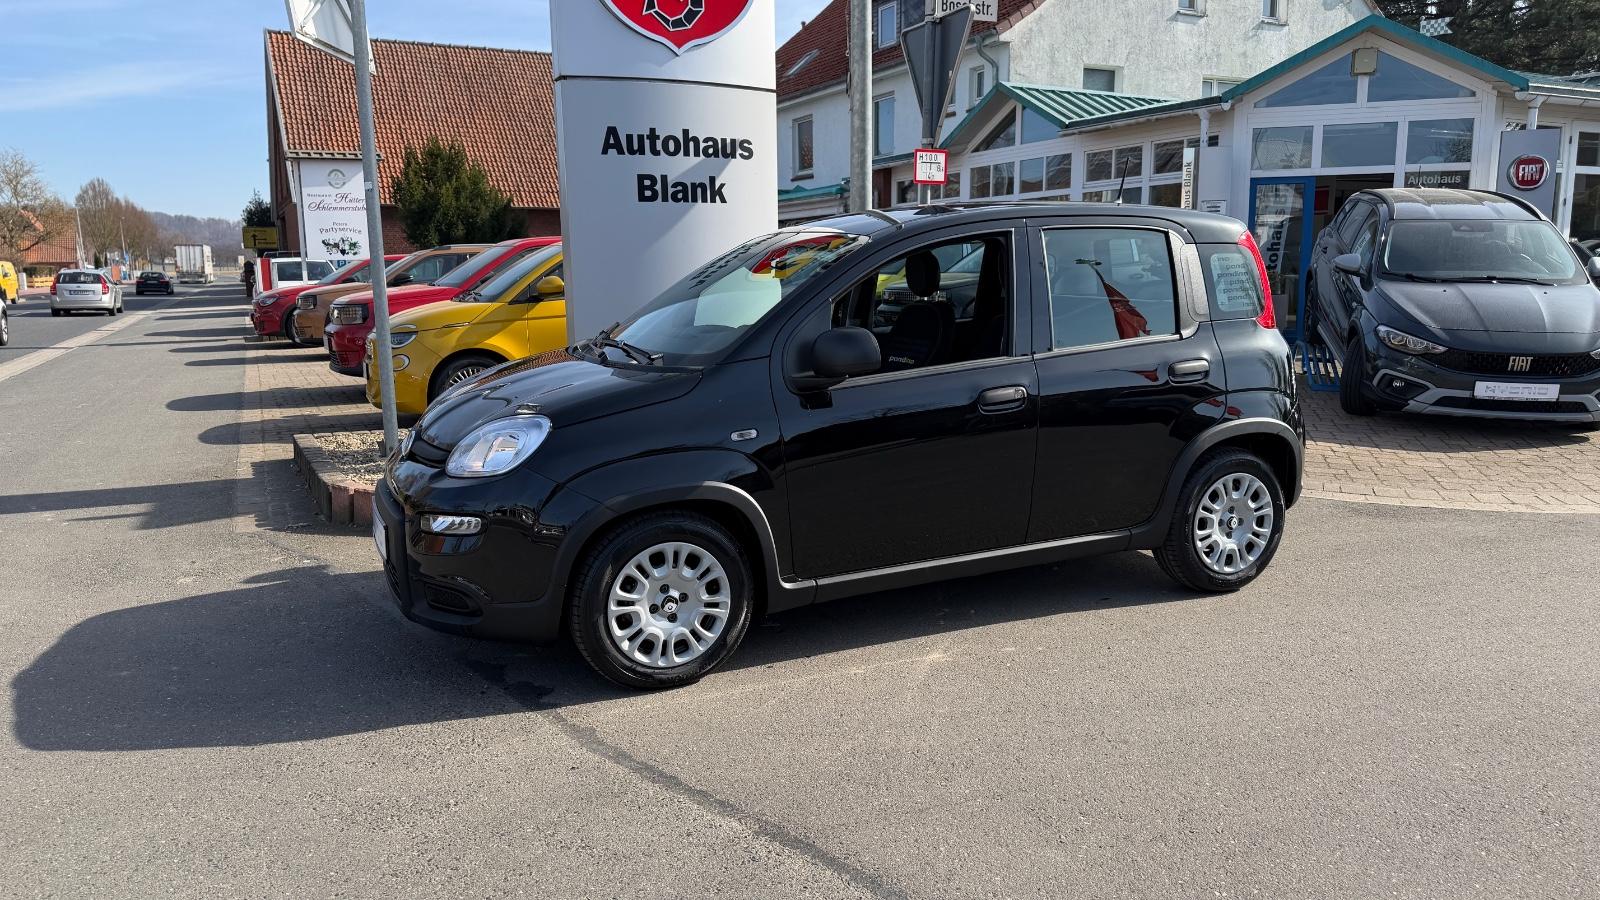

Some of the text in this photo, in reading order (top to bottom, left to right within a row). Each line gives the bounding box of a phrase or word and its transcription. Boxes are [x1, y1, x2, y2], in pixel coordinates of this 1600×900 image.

[601, 126, 754, 160] Autohaus
[1183, 161, 1192, 188] Blank
[1407, 174, 1461, 185] Autohaus
[1518, 163, 1543, 181] FIAT
[636, 173, 728, 204] Blank
[319, 226, 362, 235] Partyservice
[1507, 356, 1534, 372] FIAT
